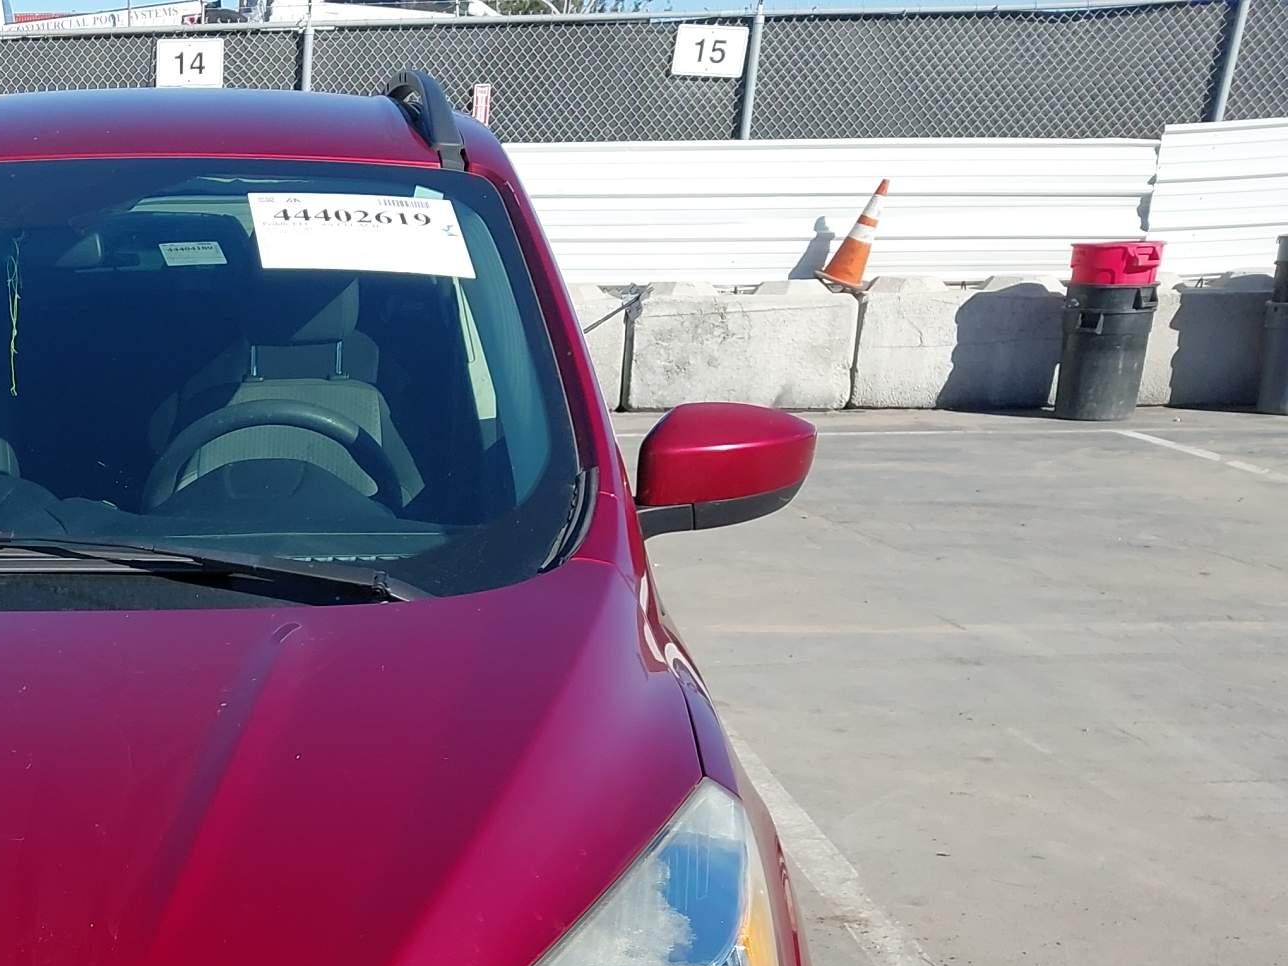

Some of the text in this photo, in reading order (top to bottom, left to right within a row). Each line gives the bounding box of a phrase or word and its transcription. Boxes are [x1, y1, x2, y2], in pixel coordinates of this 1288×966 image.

[695, 38, 727, 63] 15
[174, 51, 205, 75] 14
[273, 208, 431, 226] 44402619
